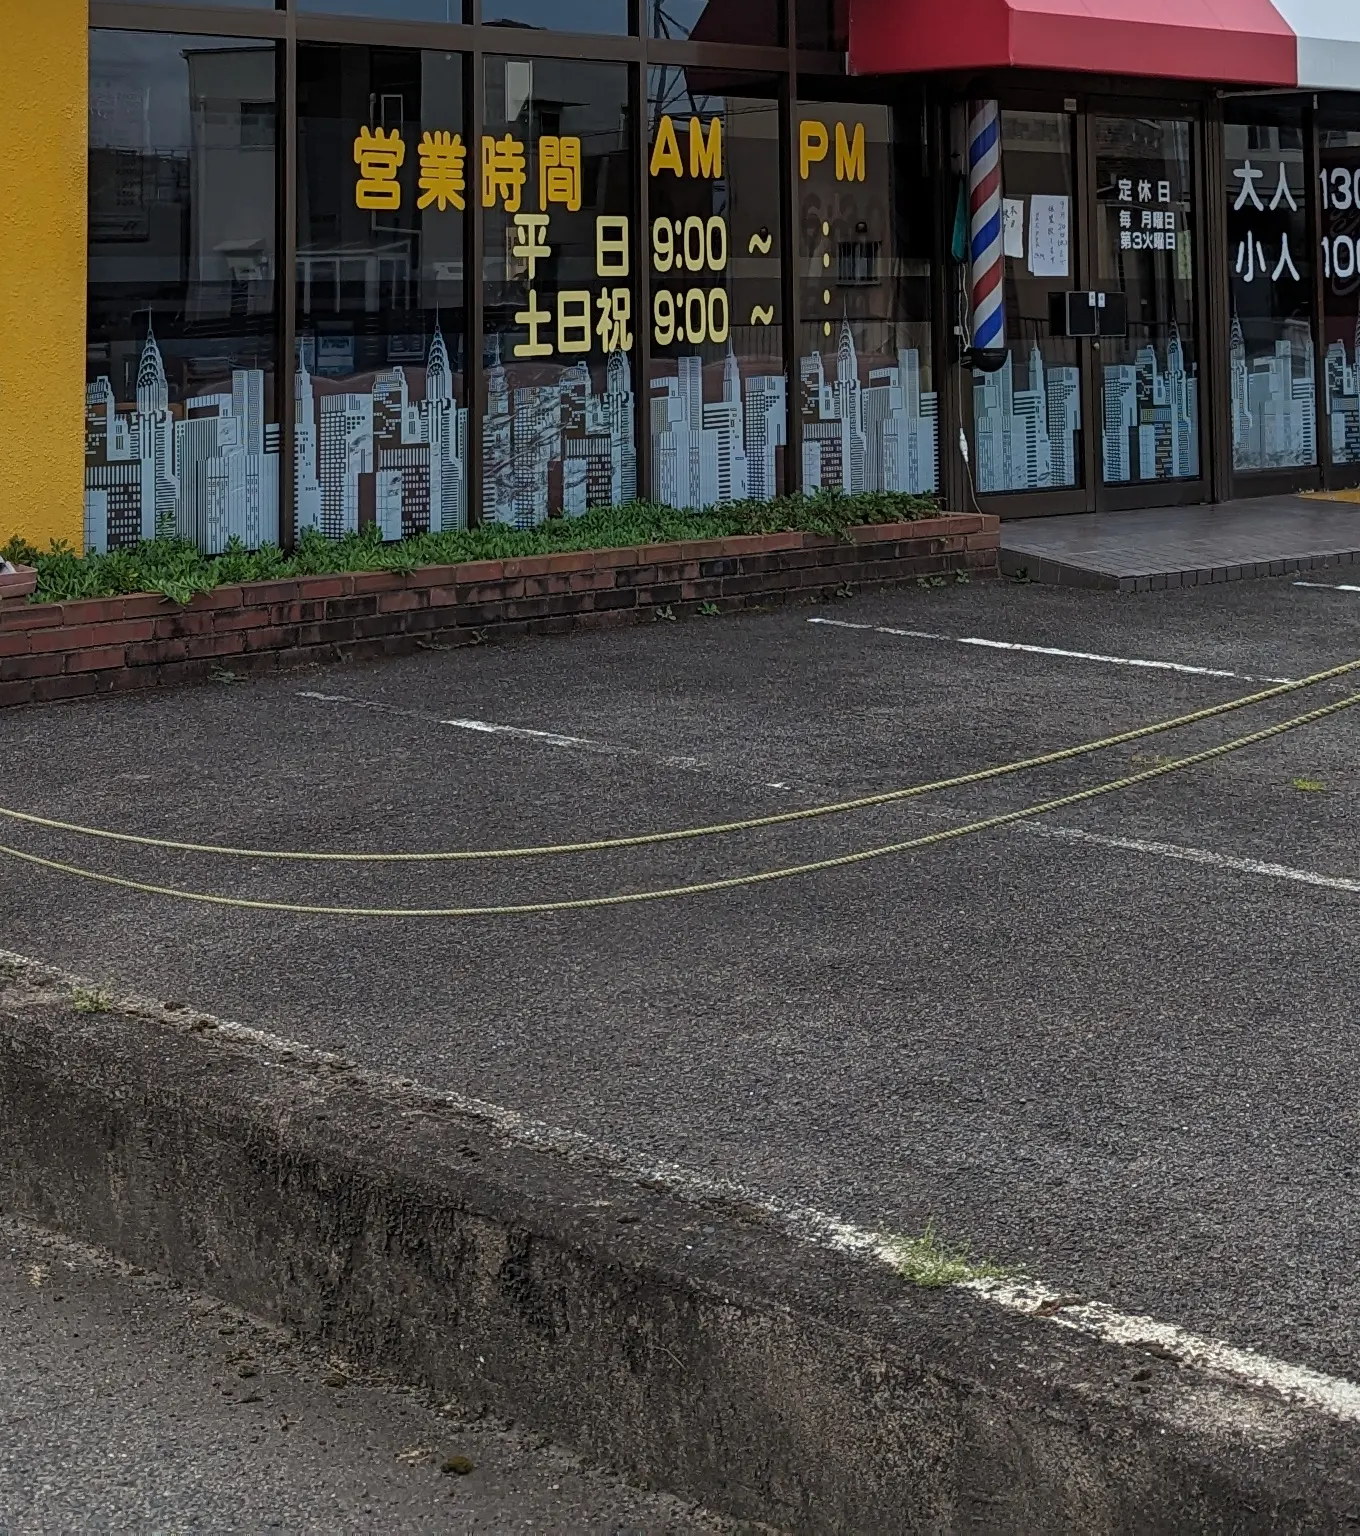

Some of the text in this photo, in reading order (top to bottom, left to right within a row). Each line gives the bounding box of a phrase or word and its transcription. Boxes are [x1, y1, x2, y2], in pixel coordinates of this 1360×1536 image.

[353, 115, 865, 212] 営業時間 AM PM
[1233, 159, 1298, 212] 大人
[1118, 178, 1171, 203] 定休日
[513, 214, 629, 280] 平日
[653, 216, 727, 272] 9:00
[1120, 231, 1176, 251] 第3火曜日
[1235, 230, 1301, 282] 小人
[513, 286, 633, 357] 土日祝
[654, 287, 729, 345] 9:00
